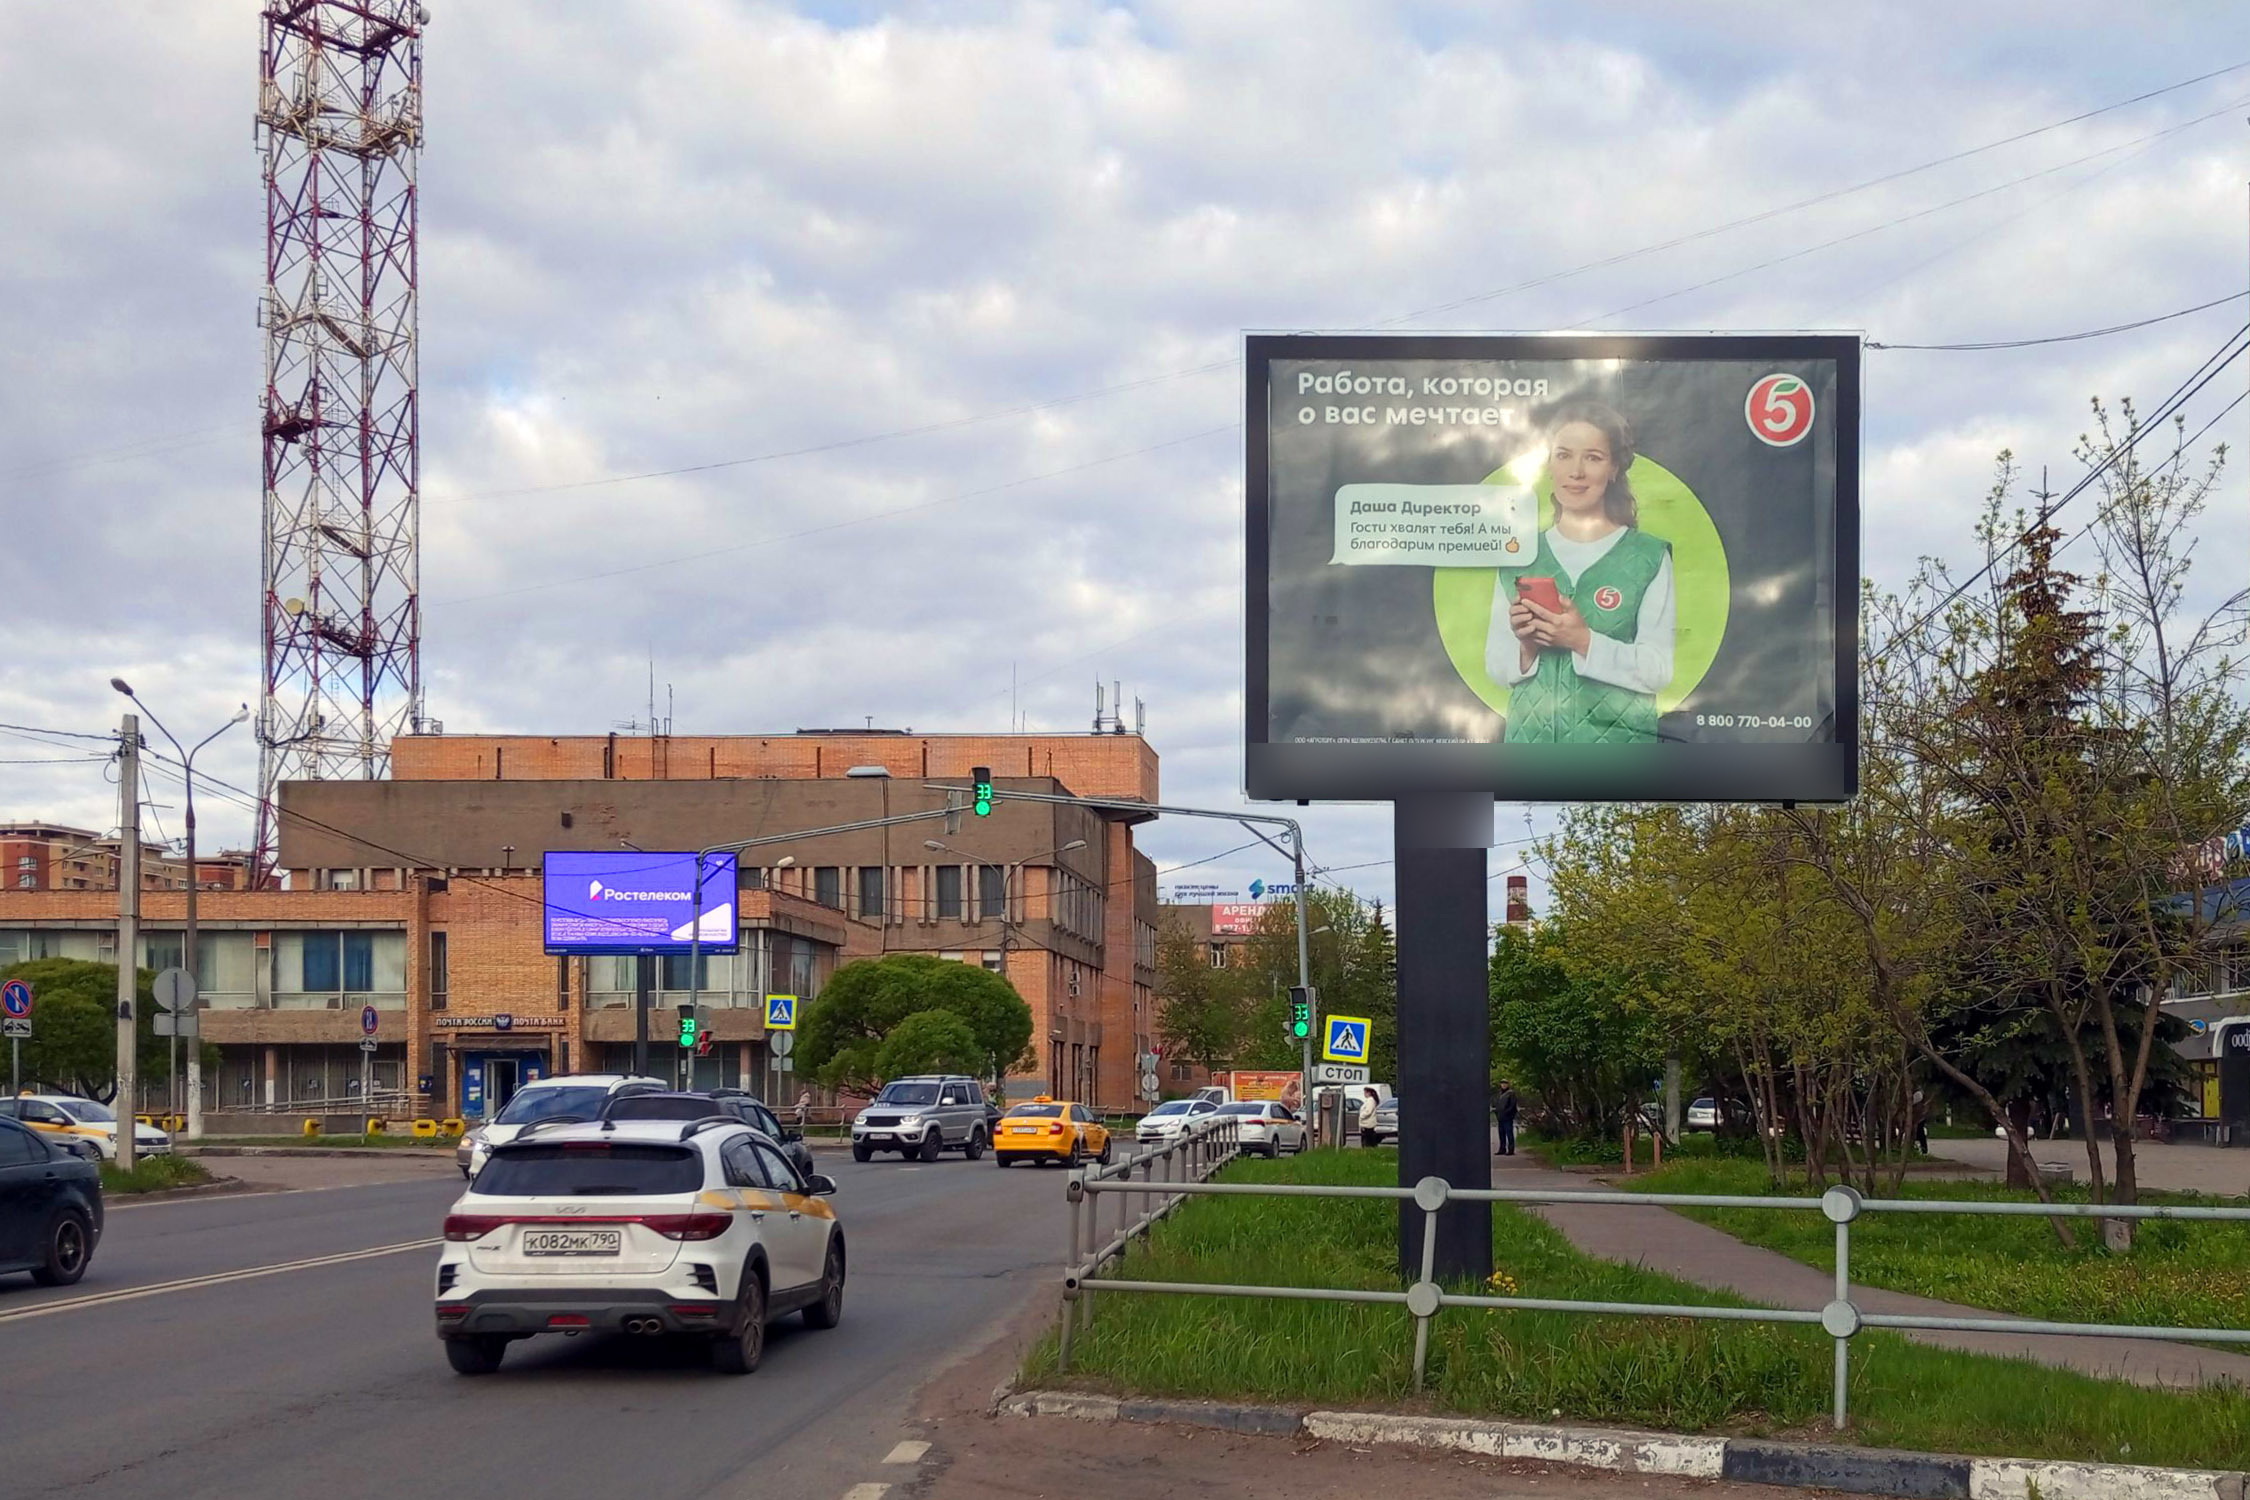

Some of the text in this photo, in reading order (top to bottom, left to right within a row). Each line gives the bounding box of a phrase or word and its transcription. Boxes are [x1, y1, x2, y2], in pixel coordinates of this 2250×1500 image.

[1298, 370, 1549, 401] Работа, которая
[1298, 405, 1515, 426] о вас мечтает
[1350, 501, 1481, 517] Даша Директор
[1350, 522, 1511, 535] Гости хвалят тебя! А мы
[1350, 537, 1502, 553] благодарим премией!
[1696, 714, 1812, 728] 8 800 770-04-00
[977, 784, 991, 799] 33
[604, 888, 692, 902] Ростелеком
[1325, 1067, 1363, 1081] СТОП
